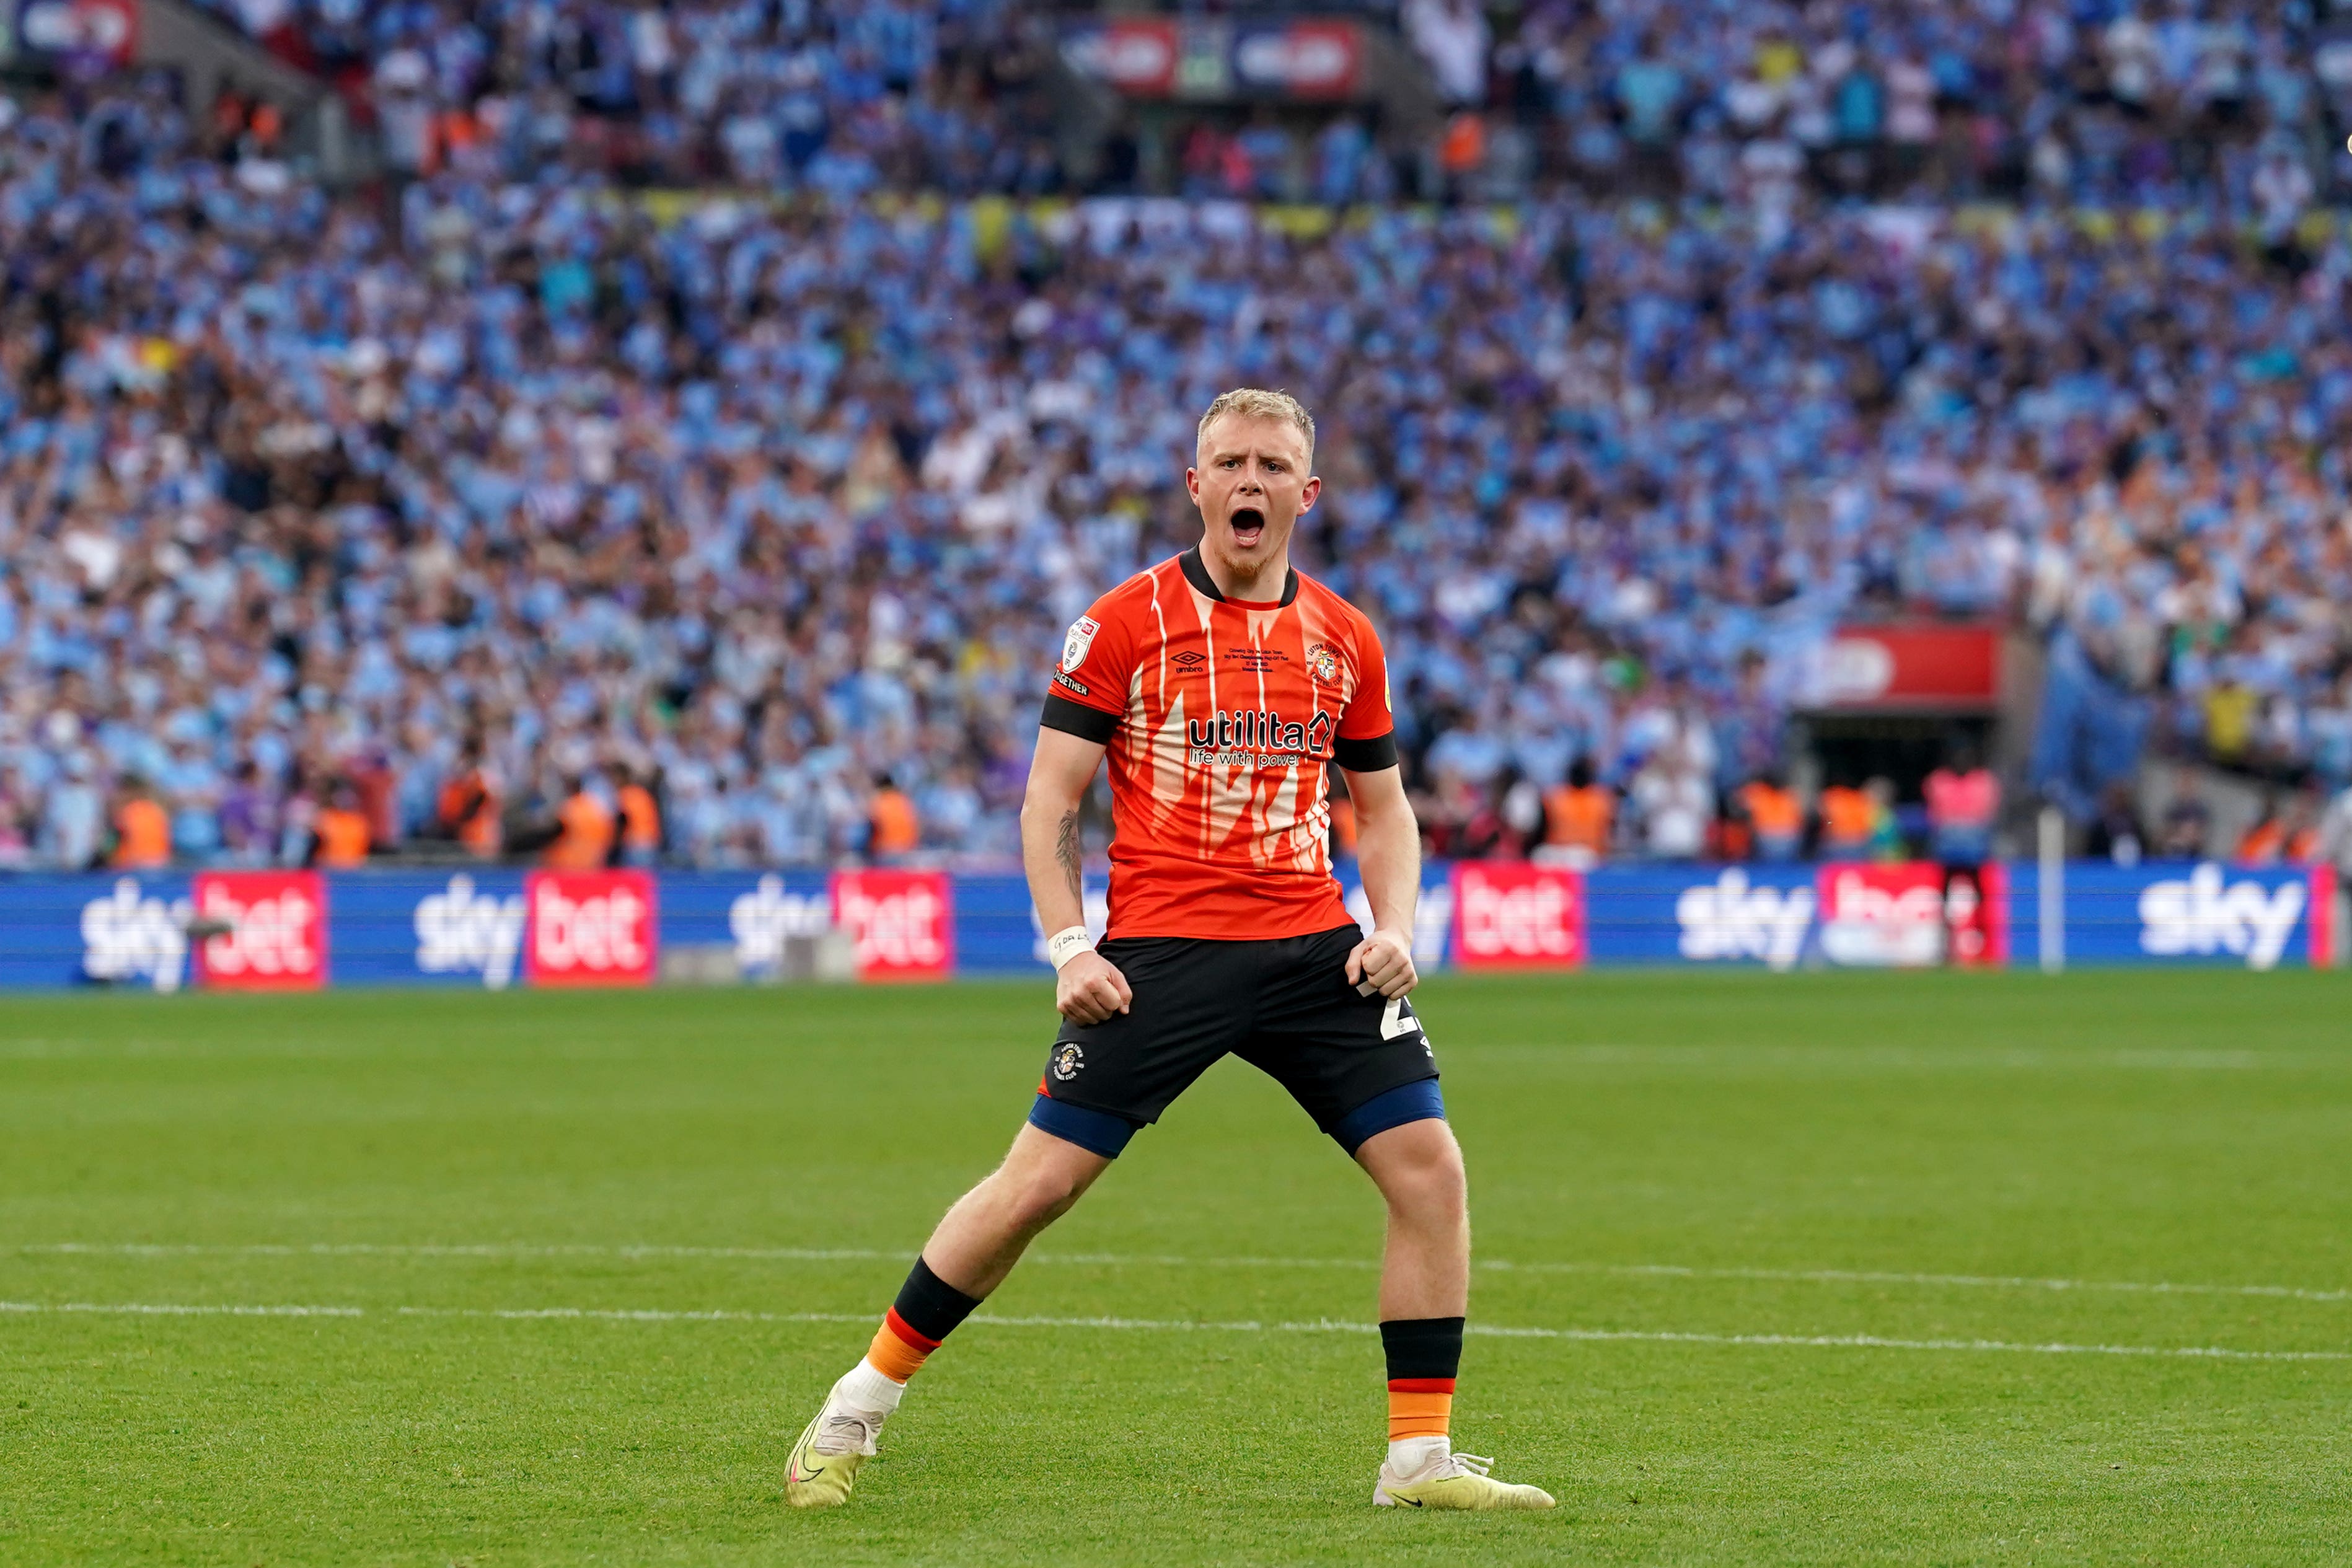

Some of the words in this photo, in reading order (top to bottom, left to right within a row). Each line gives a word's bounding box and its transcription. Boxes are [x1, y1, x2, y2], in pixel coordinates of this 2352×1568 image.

[1176, 666, 1204, 674] umbro
[1308, 643, 1324, 656] LUTON
[1325, 644, 1341, 659] TOWN
[1189, 710, 1305, 752] utilita
[1189, 748, 1213, 765] life
[1218, 751, 1254, 767] with
[1257, 753, 1300, 770] power
[79, 876, 194, 992] sky
[412, 871, 527, 990] sky
[534, 876, 648, 973] bet
[1459, 869, 1578, 958] bet
[1675, 866, 1816, 973] sky
[2137, 861, 2307, 971] sky
